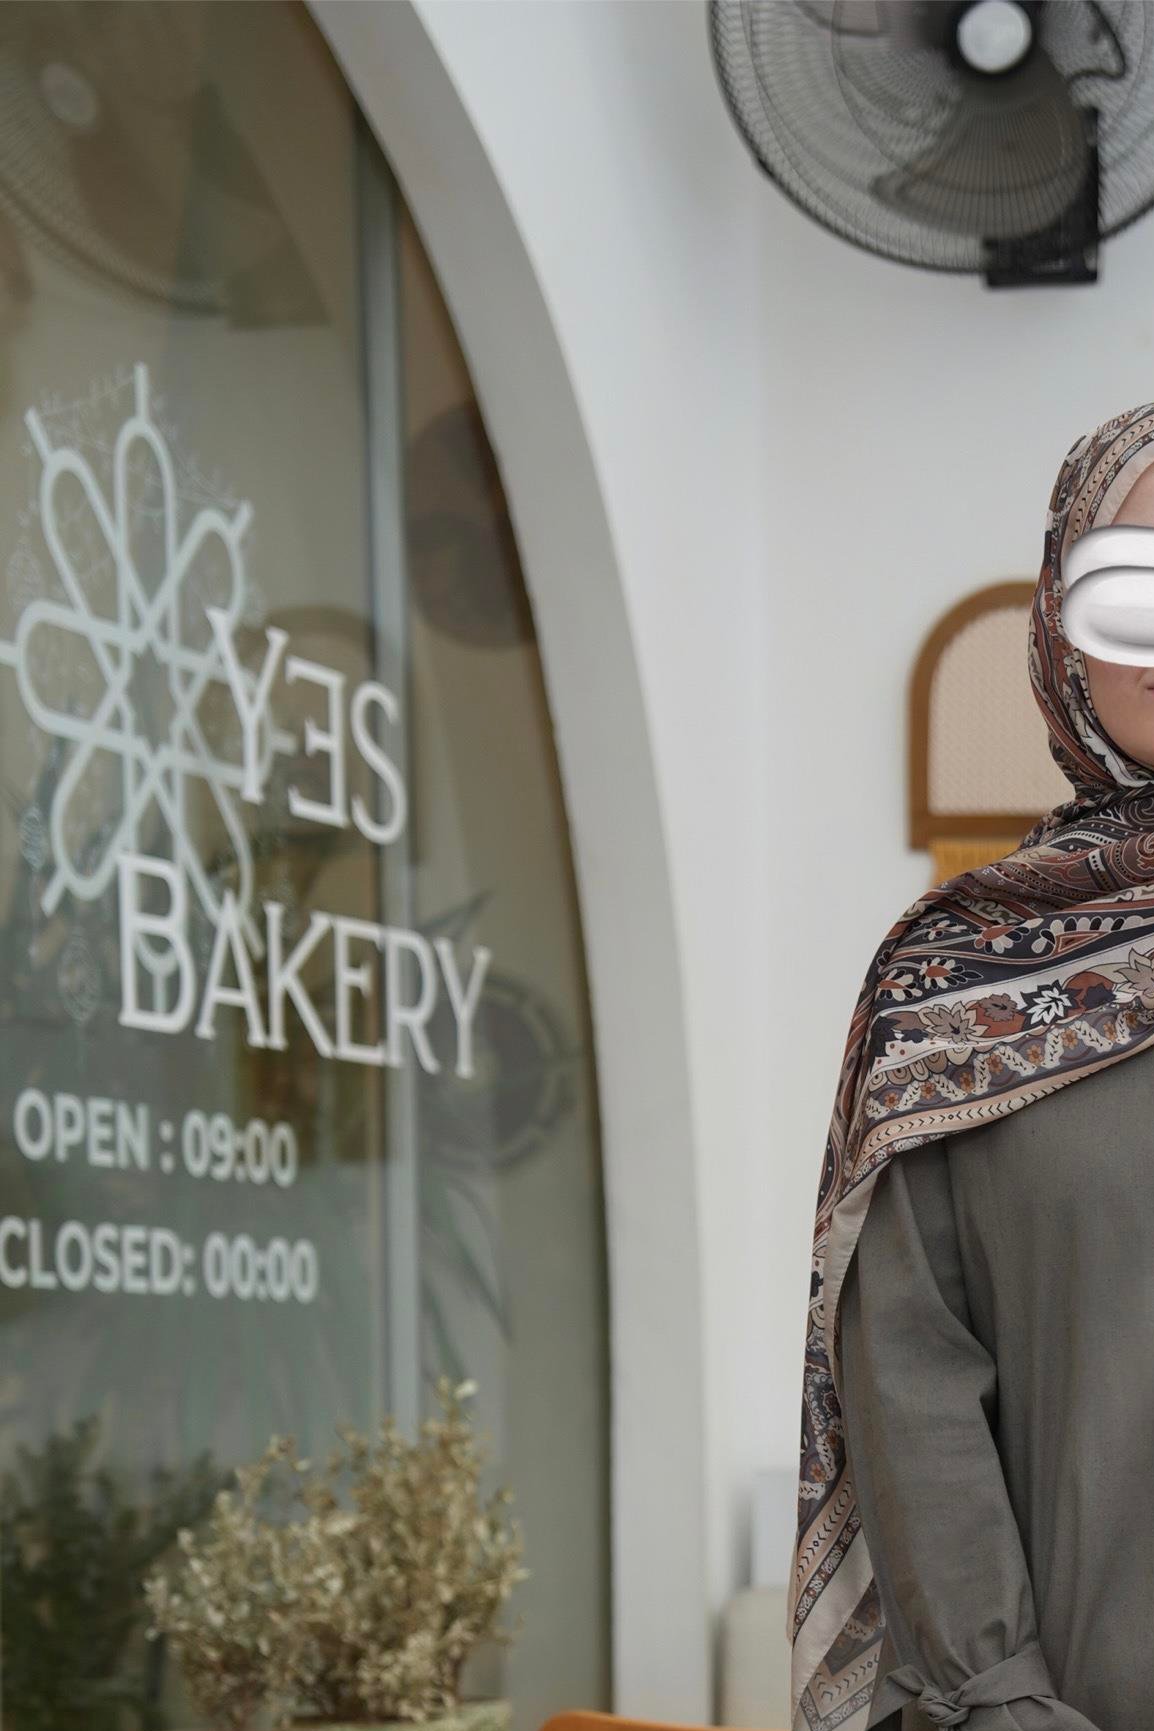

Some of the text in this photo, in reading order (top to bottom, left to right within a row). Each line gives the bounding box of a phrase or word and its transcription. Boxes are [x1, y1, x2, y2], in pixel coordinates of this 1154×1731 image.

[118, 852, 491, 1079] BAKERY
[182, 1109, 297, 1187] 09:00
[203, 1231, 319, 1303] 00:00
